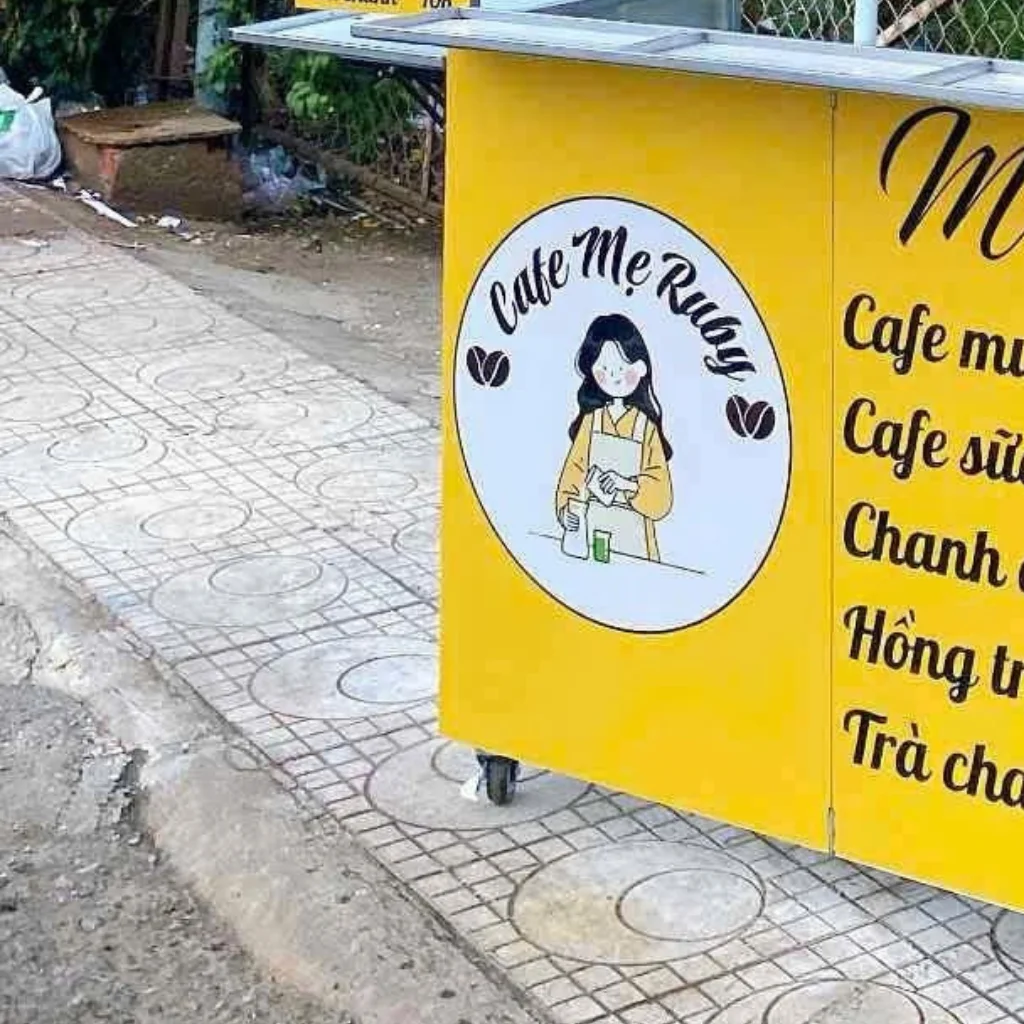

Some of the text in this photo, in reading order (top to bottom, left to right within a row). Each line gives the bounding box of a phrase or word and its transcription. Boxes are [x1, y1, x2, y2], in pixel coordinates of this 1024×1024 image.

[489, 226, 757, 382] Cafe Mẹ Ruby
[844, 294, 947, 375] Cafe
[844, 398, 947, 479] Cafe
[844, 502, 1007, 587] Chanh
[844, 606, 979, 703] Hồng
[844, 709, 931, 782] Trà
